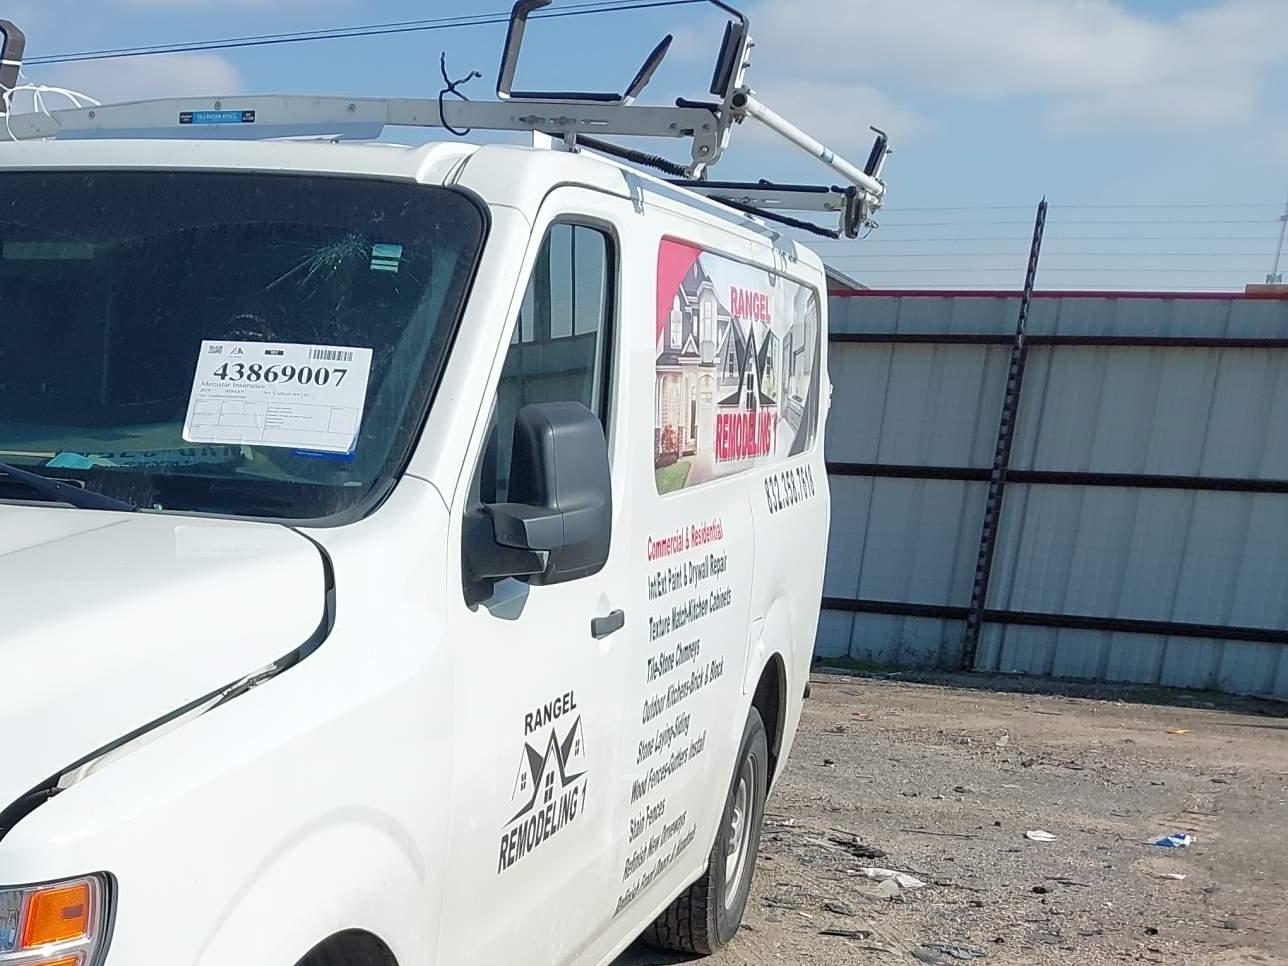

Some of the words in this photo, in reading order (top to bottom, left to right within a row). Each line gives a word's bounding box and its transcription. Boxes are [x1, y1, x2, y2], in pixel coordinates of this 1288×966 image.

[731, 286, 771, 324] RANGEL
[213, 362, 348, 387] 43869007
[715, 410, 771, 463] REMODELING
[647, 528, 684, 561] Commercial
[685, 525, 690, 550] &
[691, 518, 723, 548] Residential
[668, 564, 682, 593] Paint
[689, 554, 709, 589] Drywall
[710, 549, 727, 580] Repair
[649, 613, 670, 642] Texture
[709, 585, 732, 612] Cabinets
[647, 651, 674, 683] Tile-Stone
[675, 639, 700, 667] Chimneys
[642, 693, 666, 725] Outdoor
[710, 656, 724, 683] Block
[524, 690, 577, 736] RANGEL
[637, 738, 654, 765] Stone
[630, 770, 649, 804] Wood
[497, 786, 579, 875] REMODELING
[581, 777, 588, 814] 1
[628, 811, 645, 844] Stain
[645, 798, 666, 829] Fences
